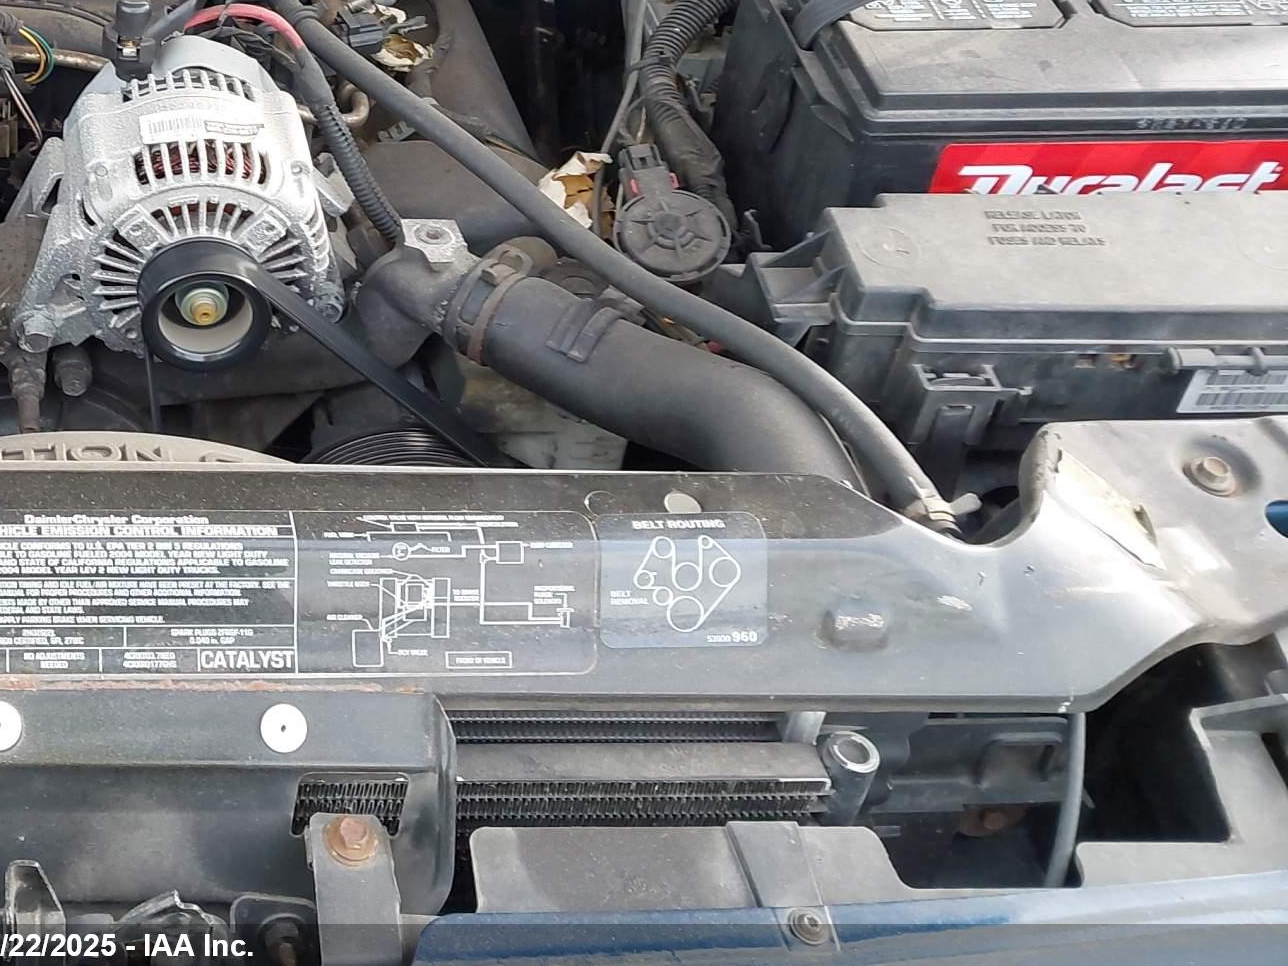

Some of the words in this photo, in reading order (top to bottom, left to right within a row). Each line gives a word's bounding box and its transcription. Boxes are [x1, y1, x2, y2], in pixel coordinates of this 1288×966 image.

[23, 514, 129, 525] DaimlerChrysler
[131, 514, 210, 525] Corporation
[632, 520, 665, 529] BELT
[668, 519, 726, 529] ROUTING
[41, 526, 110, 536] EMISSION
[114, 526, 175, 536] CONTROL
[181, 526, 278, 536] INFORMATION
[732, 632, 758, 642] 960
[200, 651, 294, 669] CATALYST
